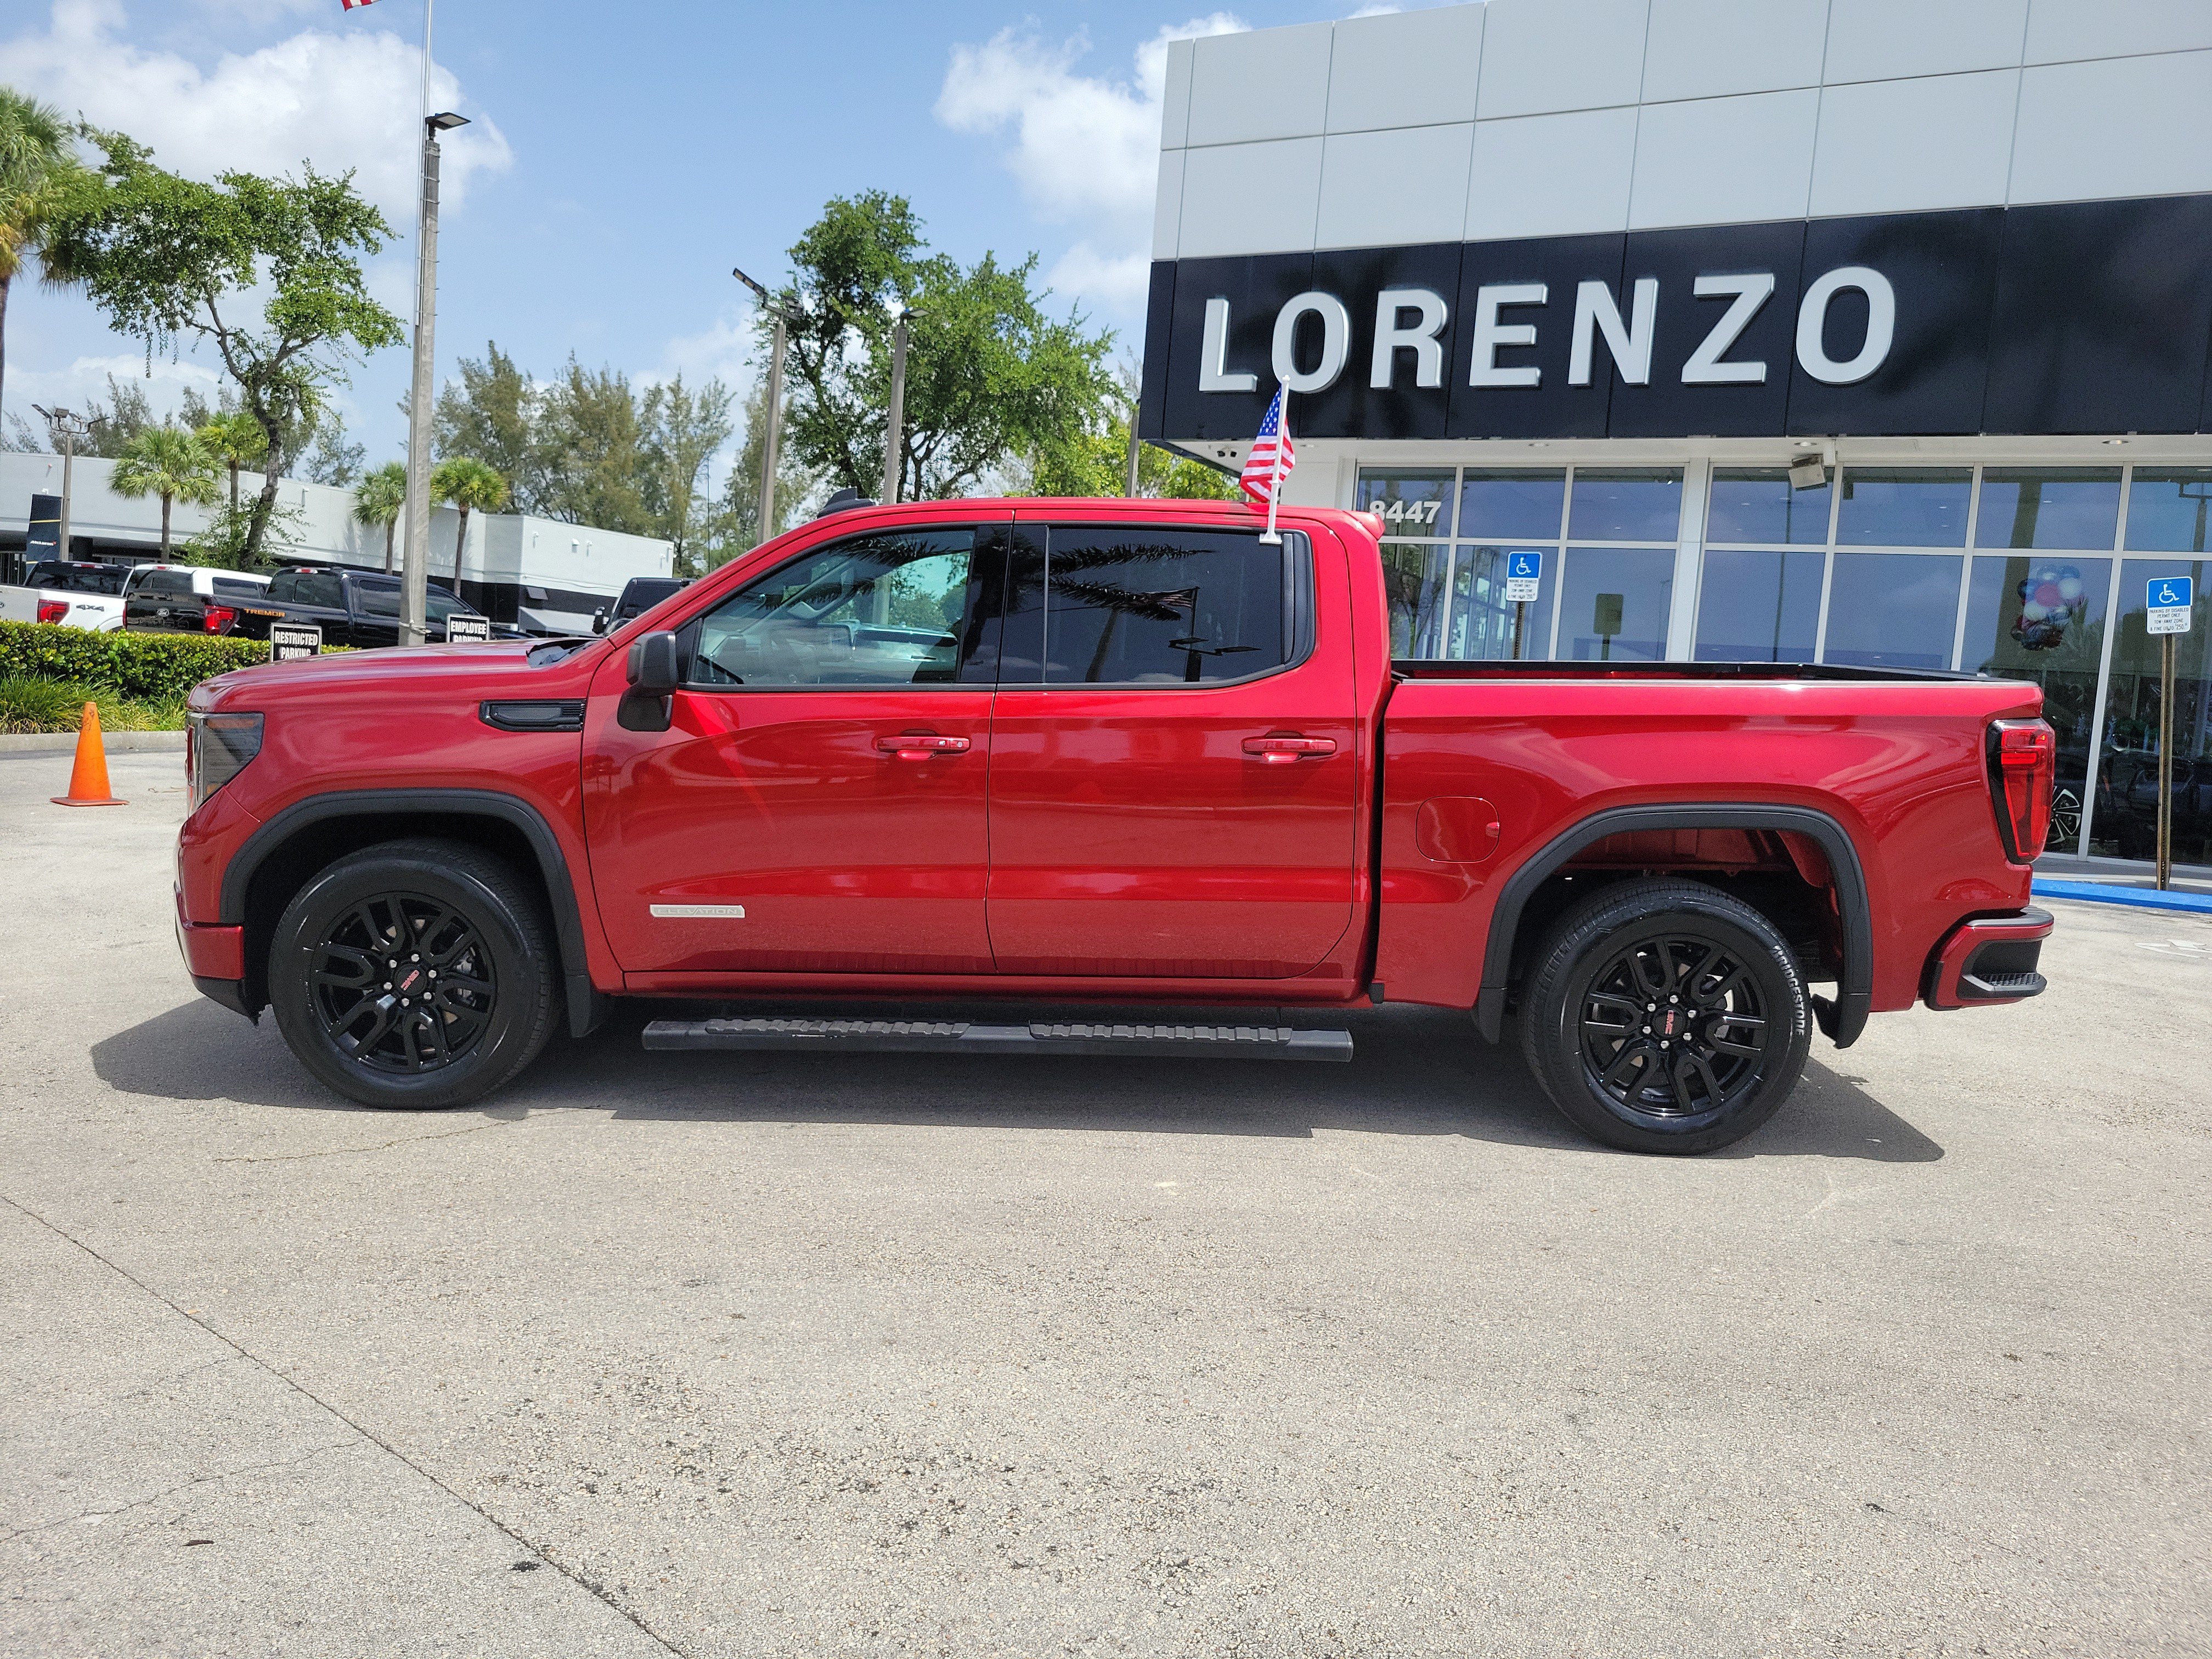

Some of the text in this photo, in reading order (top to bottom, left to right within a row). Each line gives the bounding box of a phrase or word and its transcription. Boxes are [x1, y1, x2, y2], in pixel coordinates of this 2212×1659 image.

[1199, 266, 1896, 394] LORENZO
[1369, 500, 1442, 523] 8447
[244, 608, 285, 618] TREMOR
[450, 620, 487, 635] EMPLOYEE
[275, 631, 318, 646] RESTRICTED
[280, 646, 311, 659] PARKING
